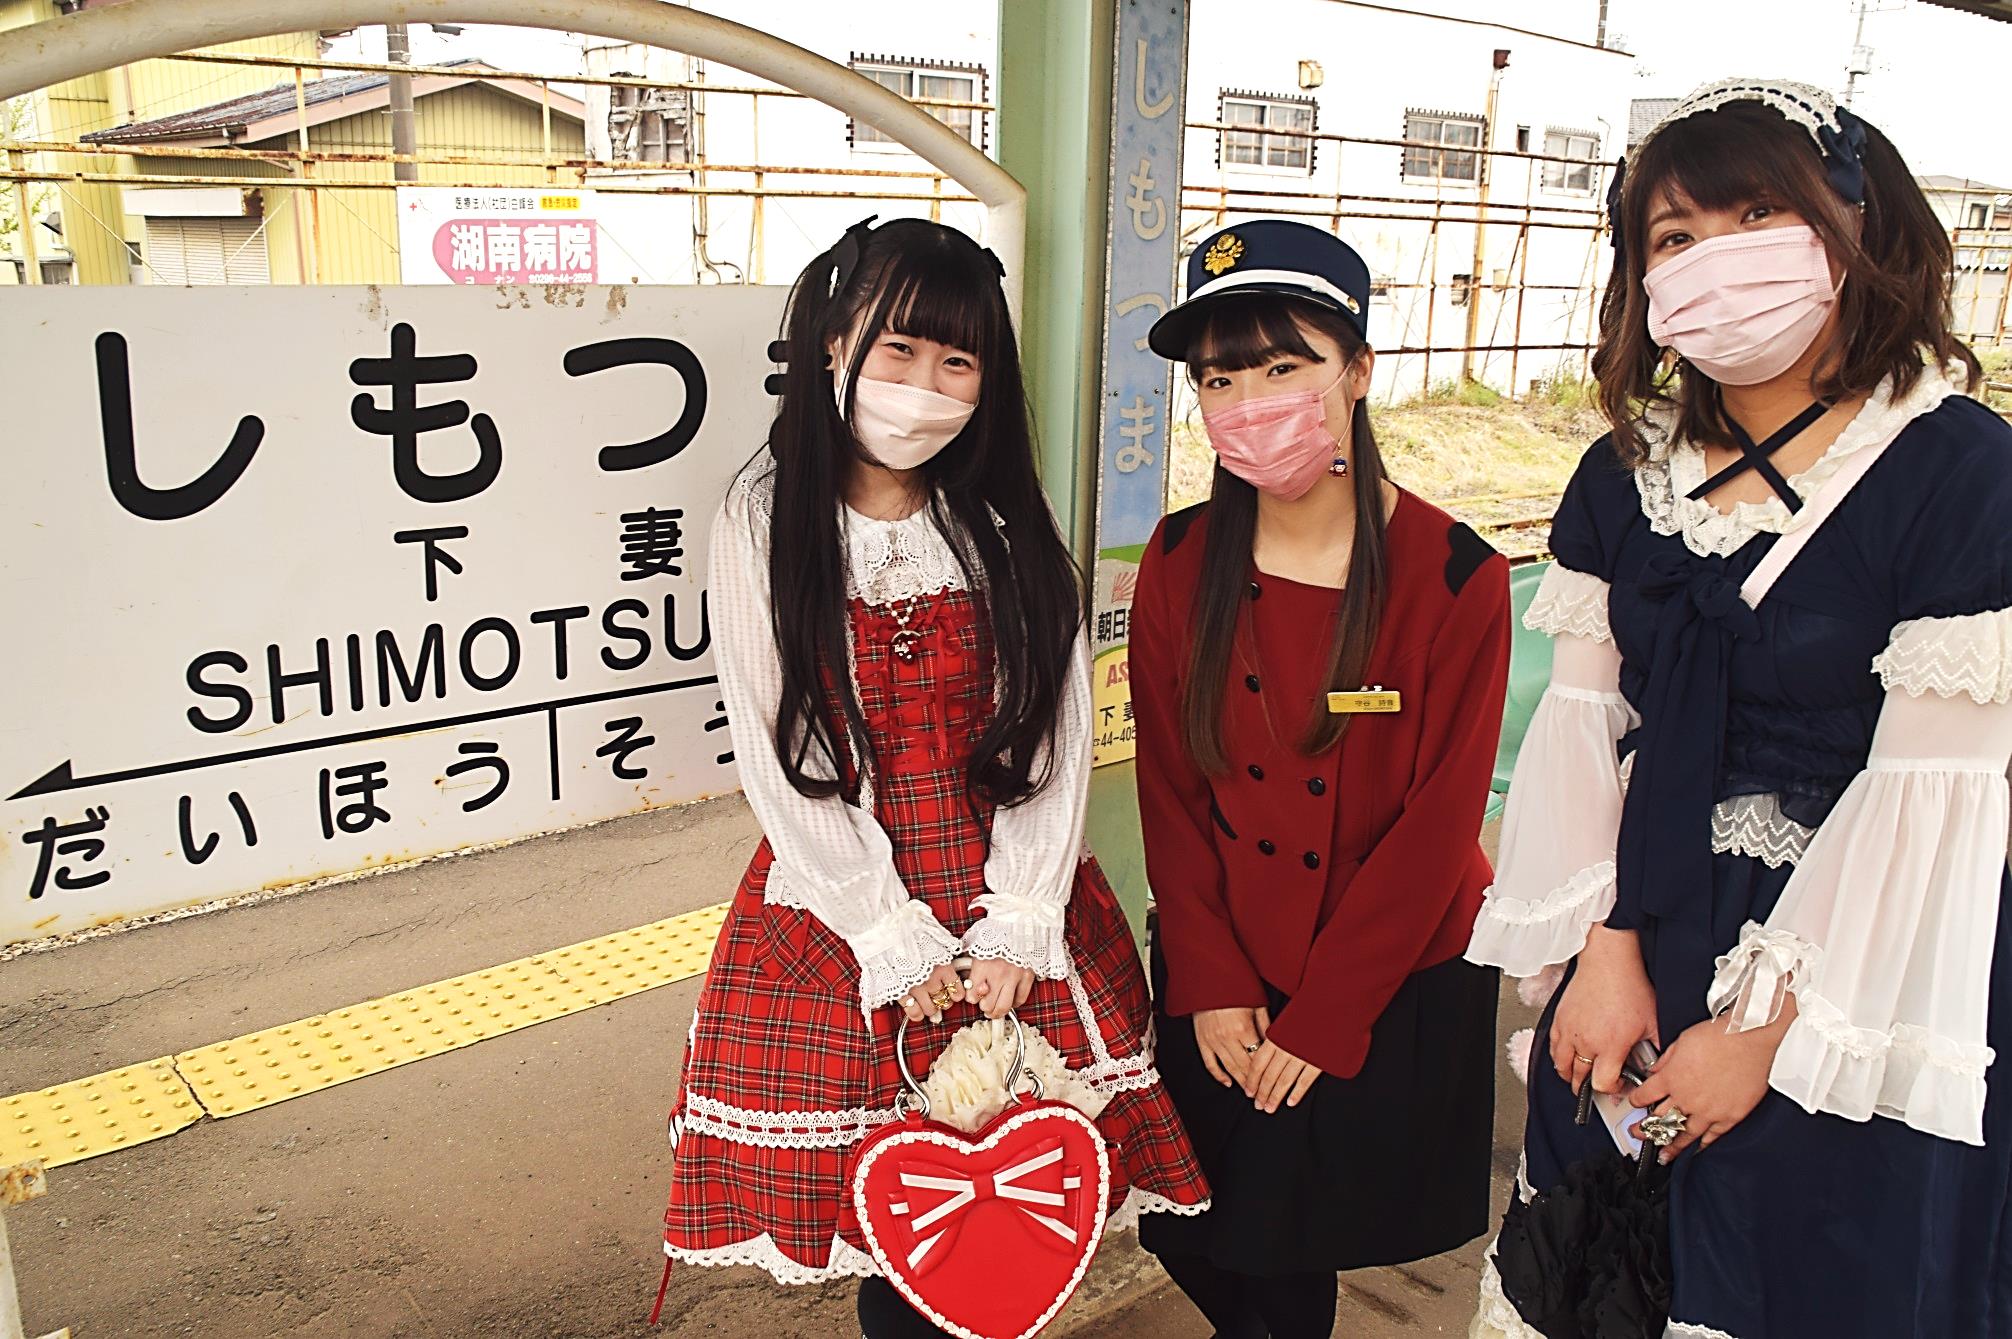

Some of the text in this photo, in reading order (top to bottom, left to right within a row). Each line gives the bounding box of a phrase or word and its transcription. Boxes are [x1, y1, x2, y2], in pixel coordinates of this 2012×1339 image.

[450, 223, 592, 272] 湖南病院
[1114, 38, 1174, 474] しもつま
[1098, 608, 1131, 642] 朝日
[22, 742, 509, 899] だいほう
